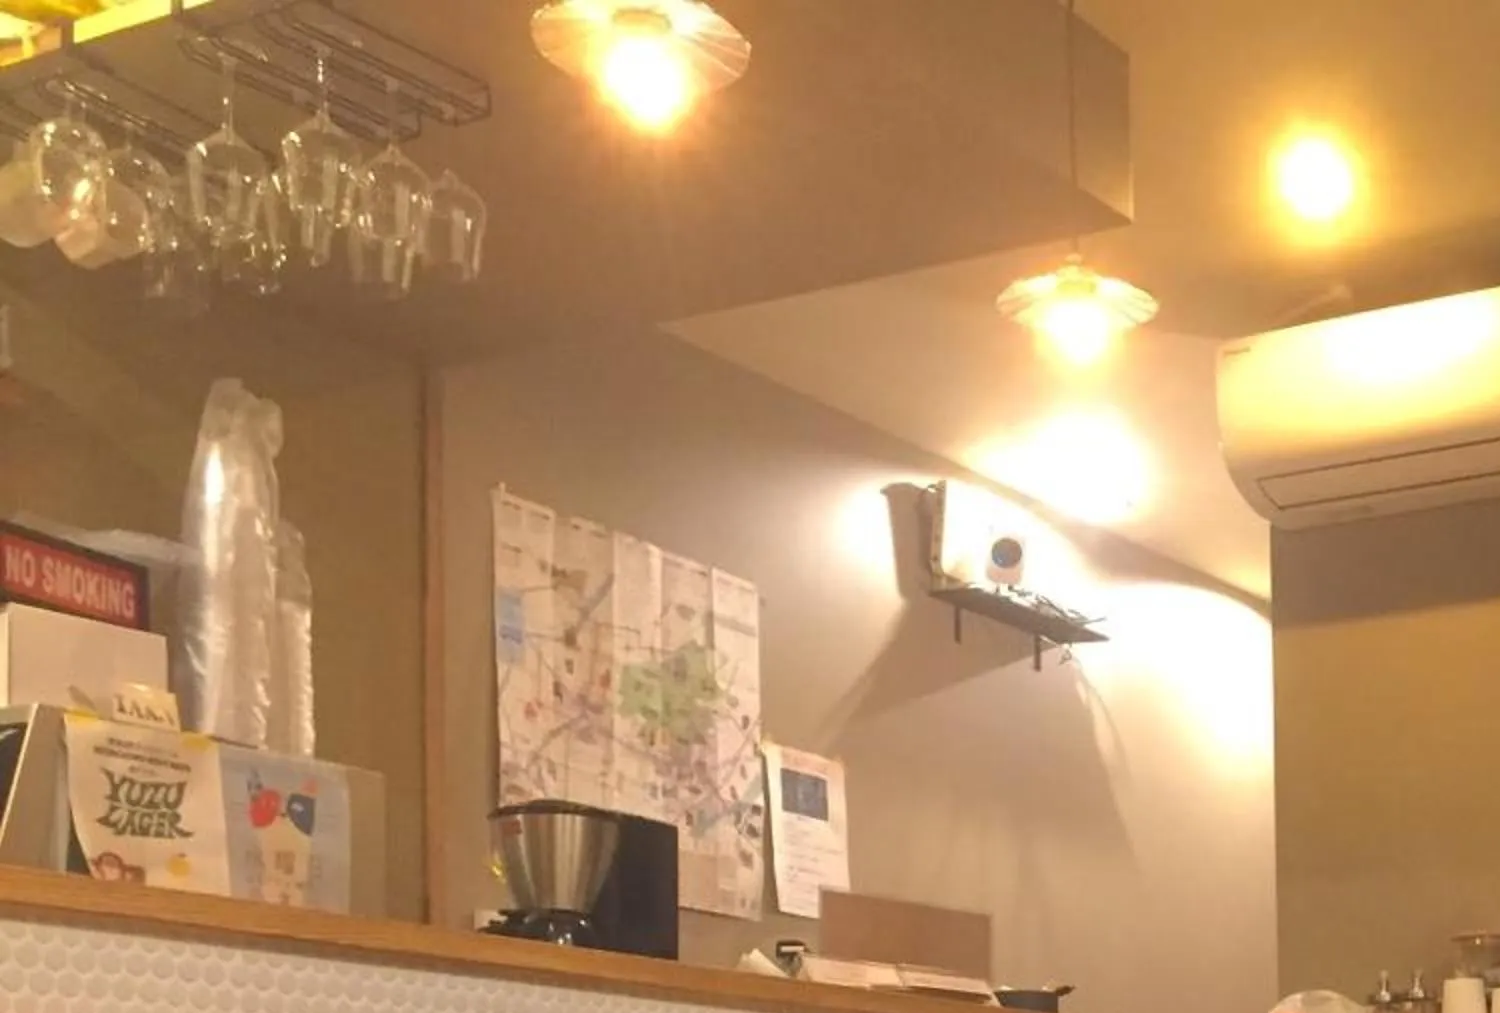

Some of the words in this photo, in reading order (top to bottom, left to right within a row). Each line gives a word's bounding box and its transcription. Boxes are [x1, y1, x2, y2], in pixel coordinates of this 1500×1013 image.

[4, 544, 36, 588] NO
[42, 555, 136, 619] SMOKING
[100, 767, 188, 809] YUZU
[96, 805, 195, 839] LAGER
